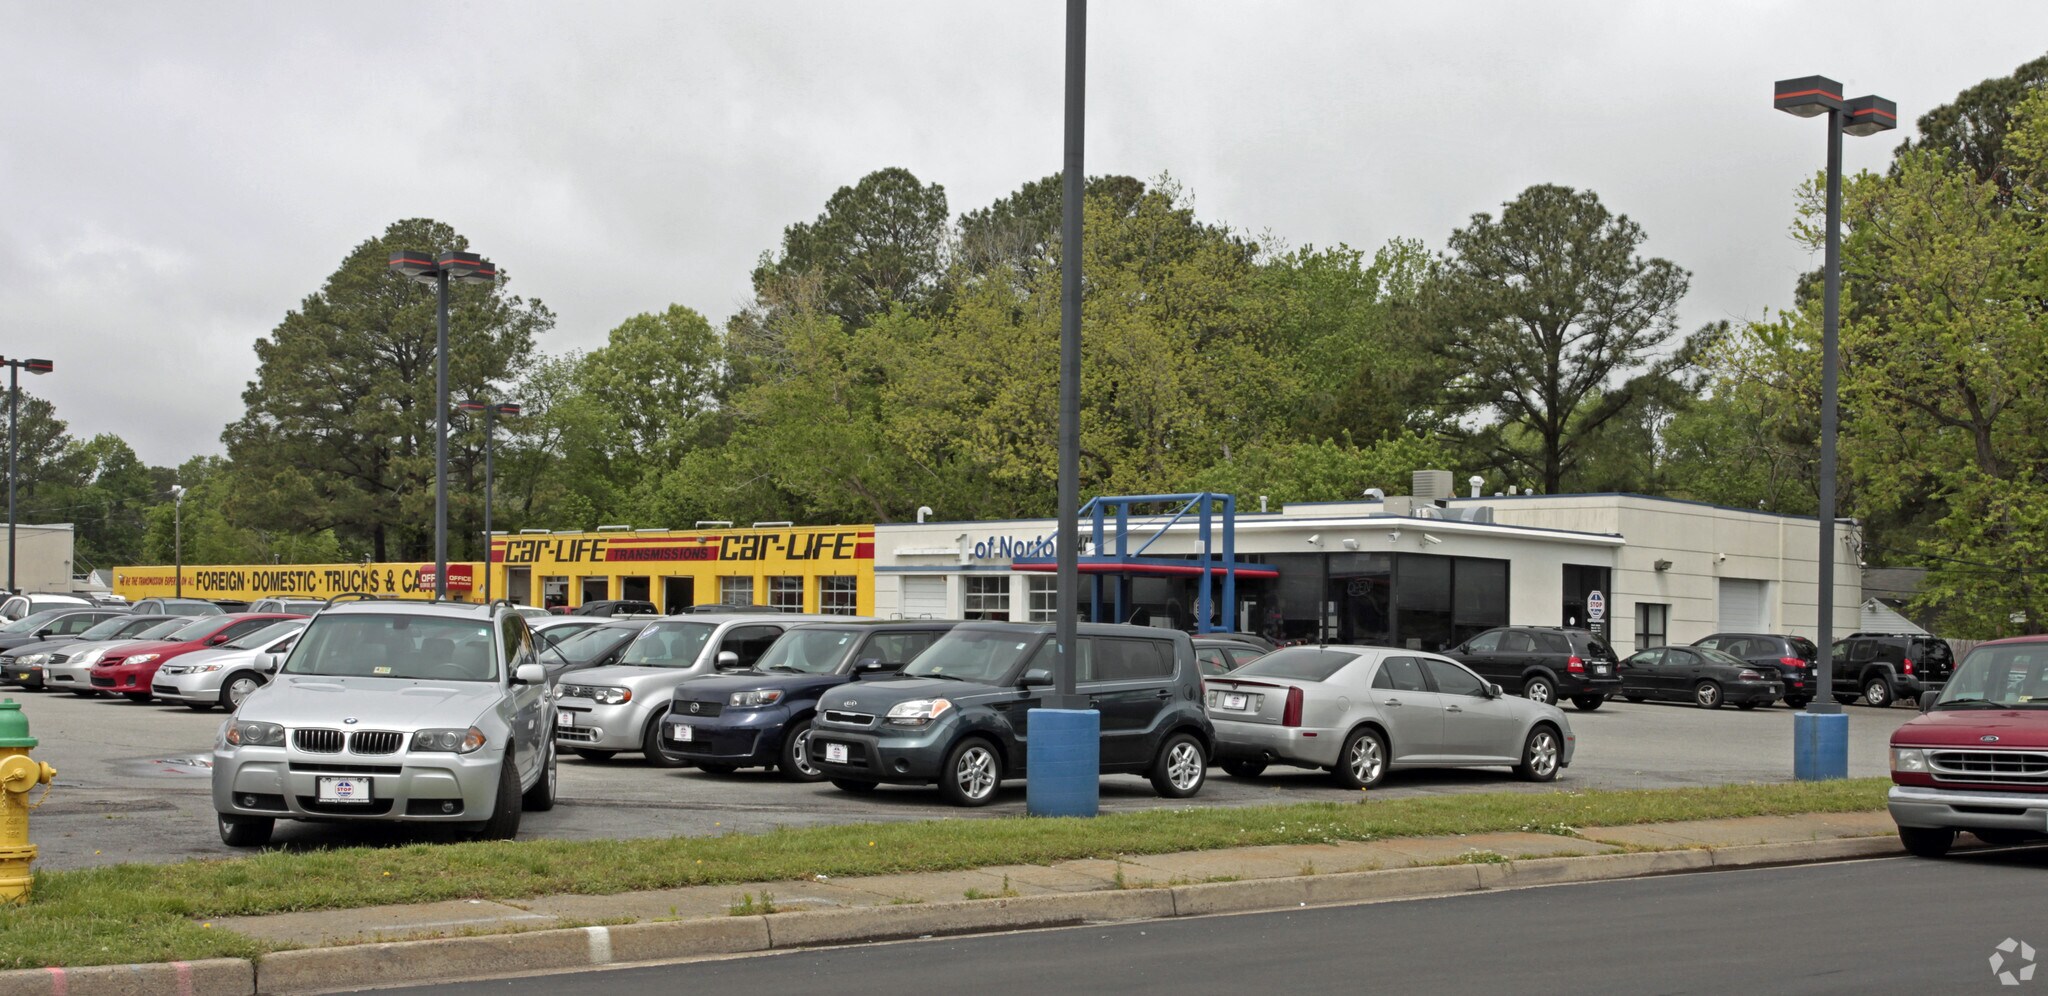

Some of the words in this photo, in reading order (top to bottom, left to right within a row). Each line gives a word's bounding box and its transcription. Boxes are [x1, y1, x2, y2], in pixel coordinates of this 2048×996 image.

[614, 547, 708, 560] TRANSMISSIONS
[975, 536, 994, 559] of
[1000, 535, 1056, 558] Norfo
[196, 571, 245, 591] FOREIGN
[252, 570, 317, 592] DOMESTIC
[324, 570, 379, 592] TRUCKS
[383, 570, 396, 592] &
